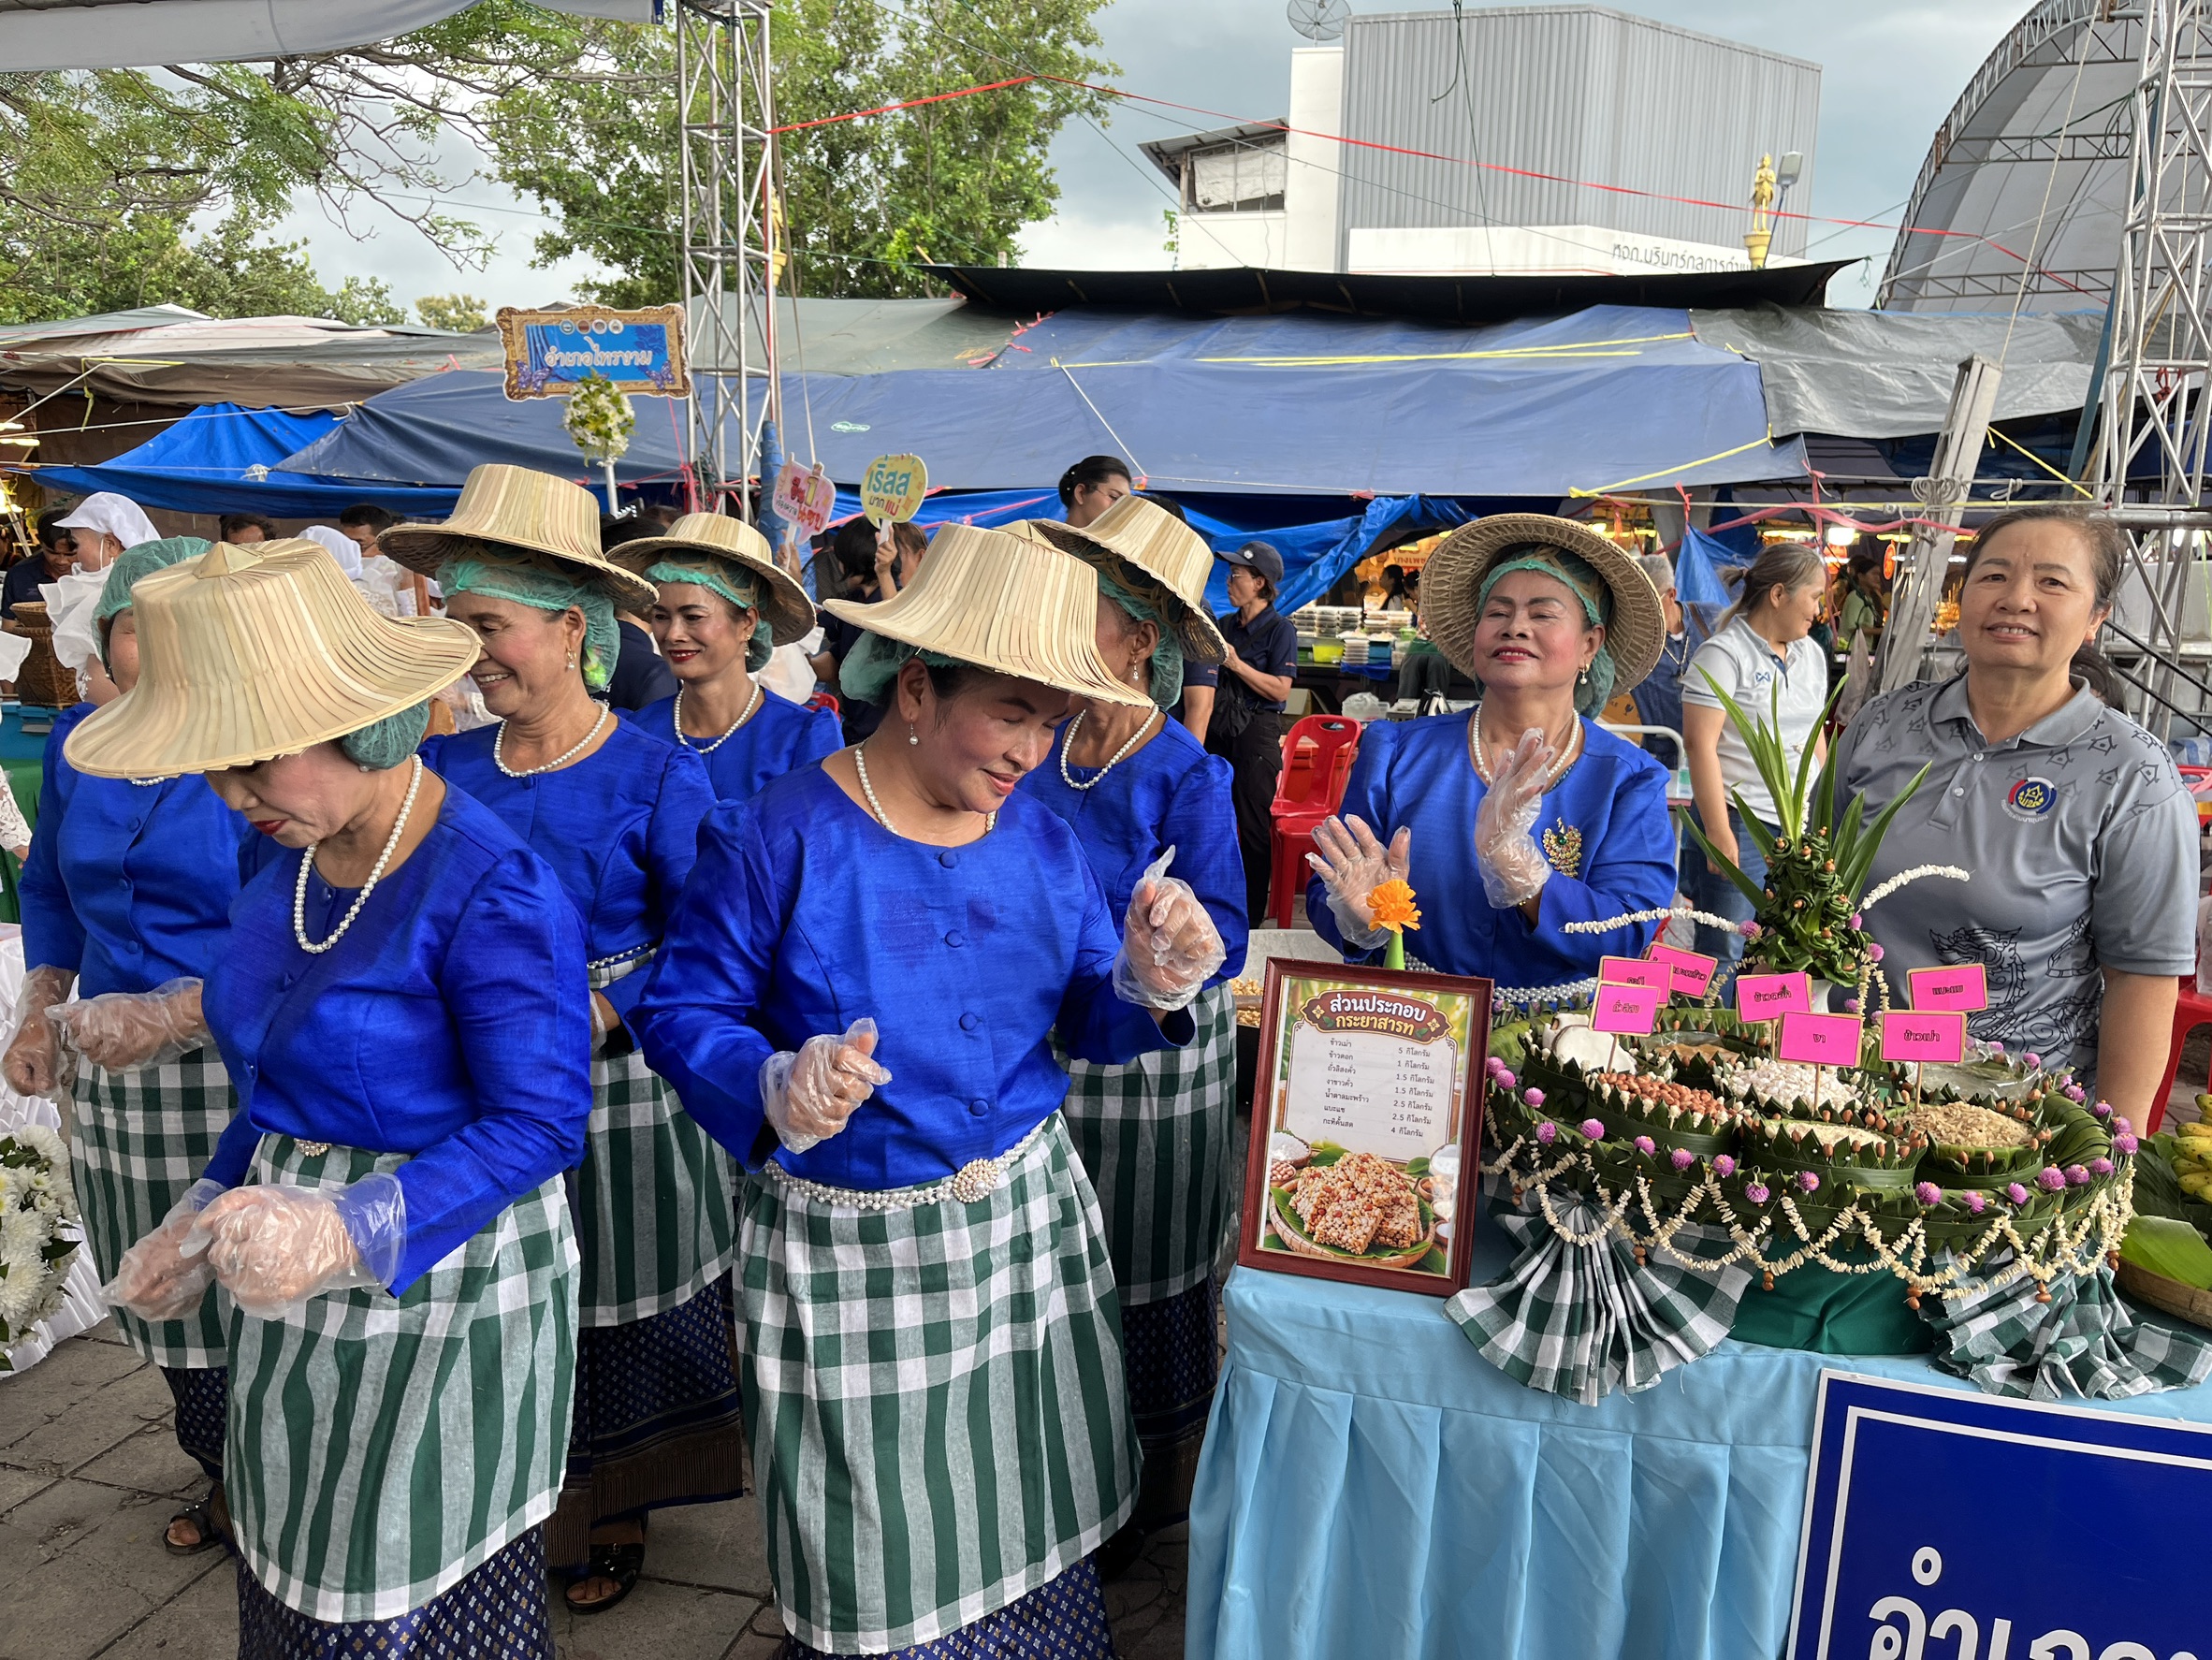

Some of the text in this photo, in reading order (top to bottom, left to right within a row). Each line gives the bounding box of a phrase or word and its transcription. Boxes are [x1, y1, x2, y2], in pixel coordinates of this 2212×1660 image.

[545, 335, 653, 367] อำเภอไทรงาม
[1329, 993, 1427, 1023] ส่วนประกอบ
[1334, 1014, 1415, 1037] กระยาสารท
[1812, 1033, 1826, 1043] งา
[1405, 1047, 1431, 1057] กิโลกรัม
[1404, 1060, 1430, 1070] กิโลกรัม
[1396, 1073, 1407, 1082] 1.5
[1409, 1073, 1435, 1085] กิโลกรัม
[1395, 1086, 1406, 1095] 1.5
[1408, 1086, 1433, 1098] กิโลกรัม
[1393, 1099, 1405, 1108] 2.5
[1407, 1100, 1433, 1112] กิโลกรัม
[1392, 1113, 1404, 1122] 2.5
[1406, 1114, 1432, 1125] กิโลกรัม
[1398, 1127, 1423, 1137] กิโลกรัม
